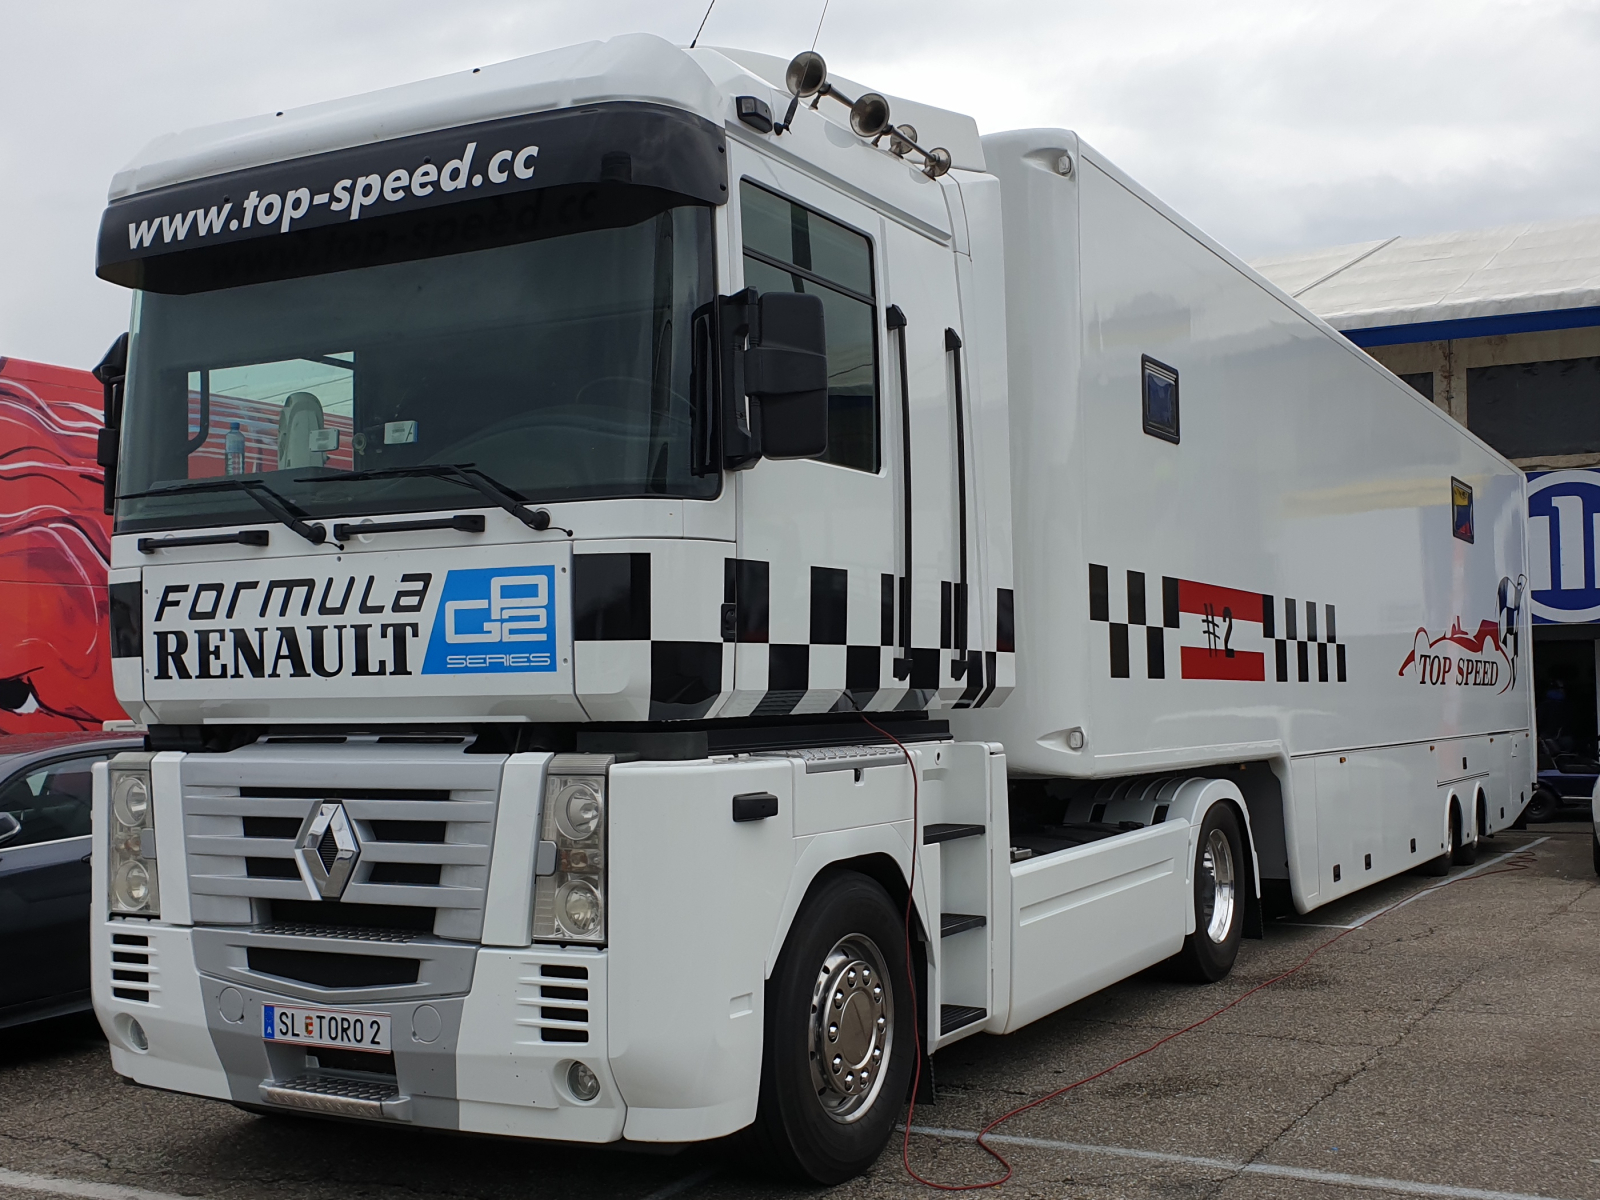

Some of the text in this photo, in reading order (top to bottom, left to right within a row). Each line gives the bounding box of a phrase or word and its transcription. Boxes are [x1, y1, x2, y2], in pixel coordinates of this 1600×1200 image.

[127, 141, 539, 250] www.top-speed.cc
[444, 574, 548, 644] GP2
[1201, 602, 1236, 659] #2
[153, 622, 420, 681] RENAULT
[446, 653, 551, 668] SERIES
[1419, 654, 1499, 687] TOP SPEED
[279, 1011, 381, 1045] SL TORO 2
